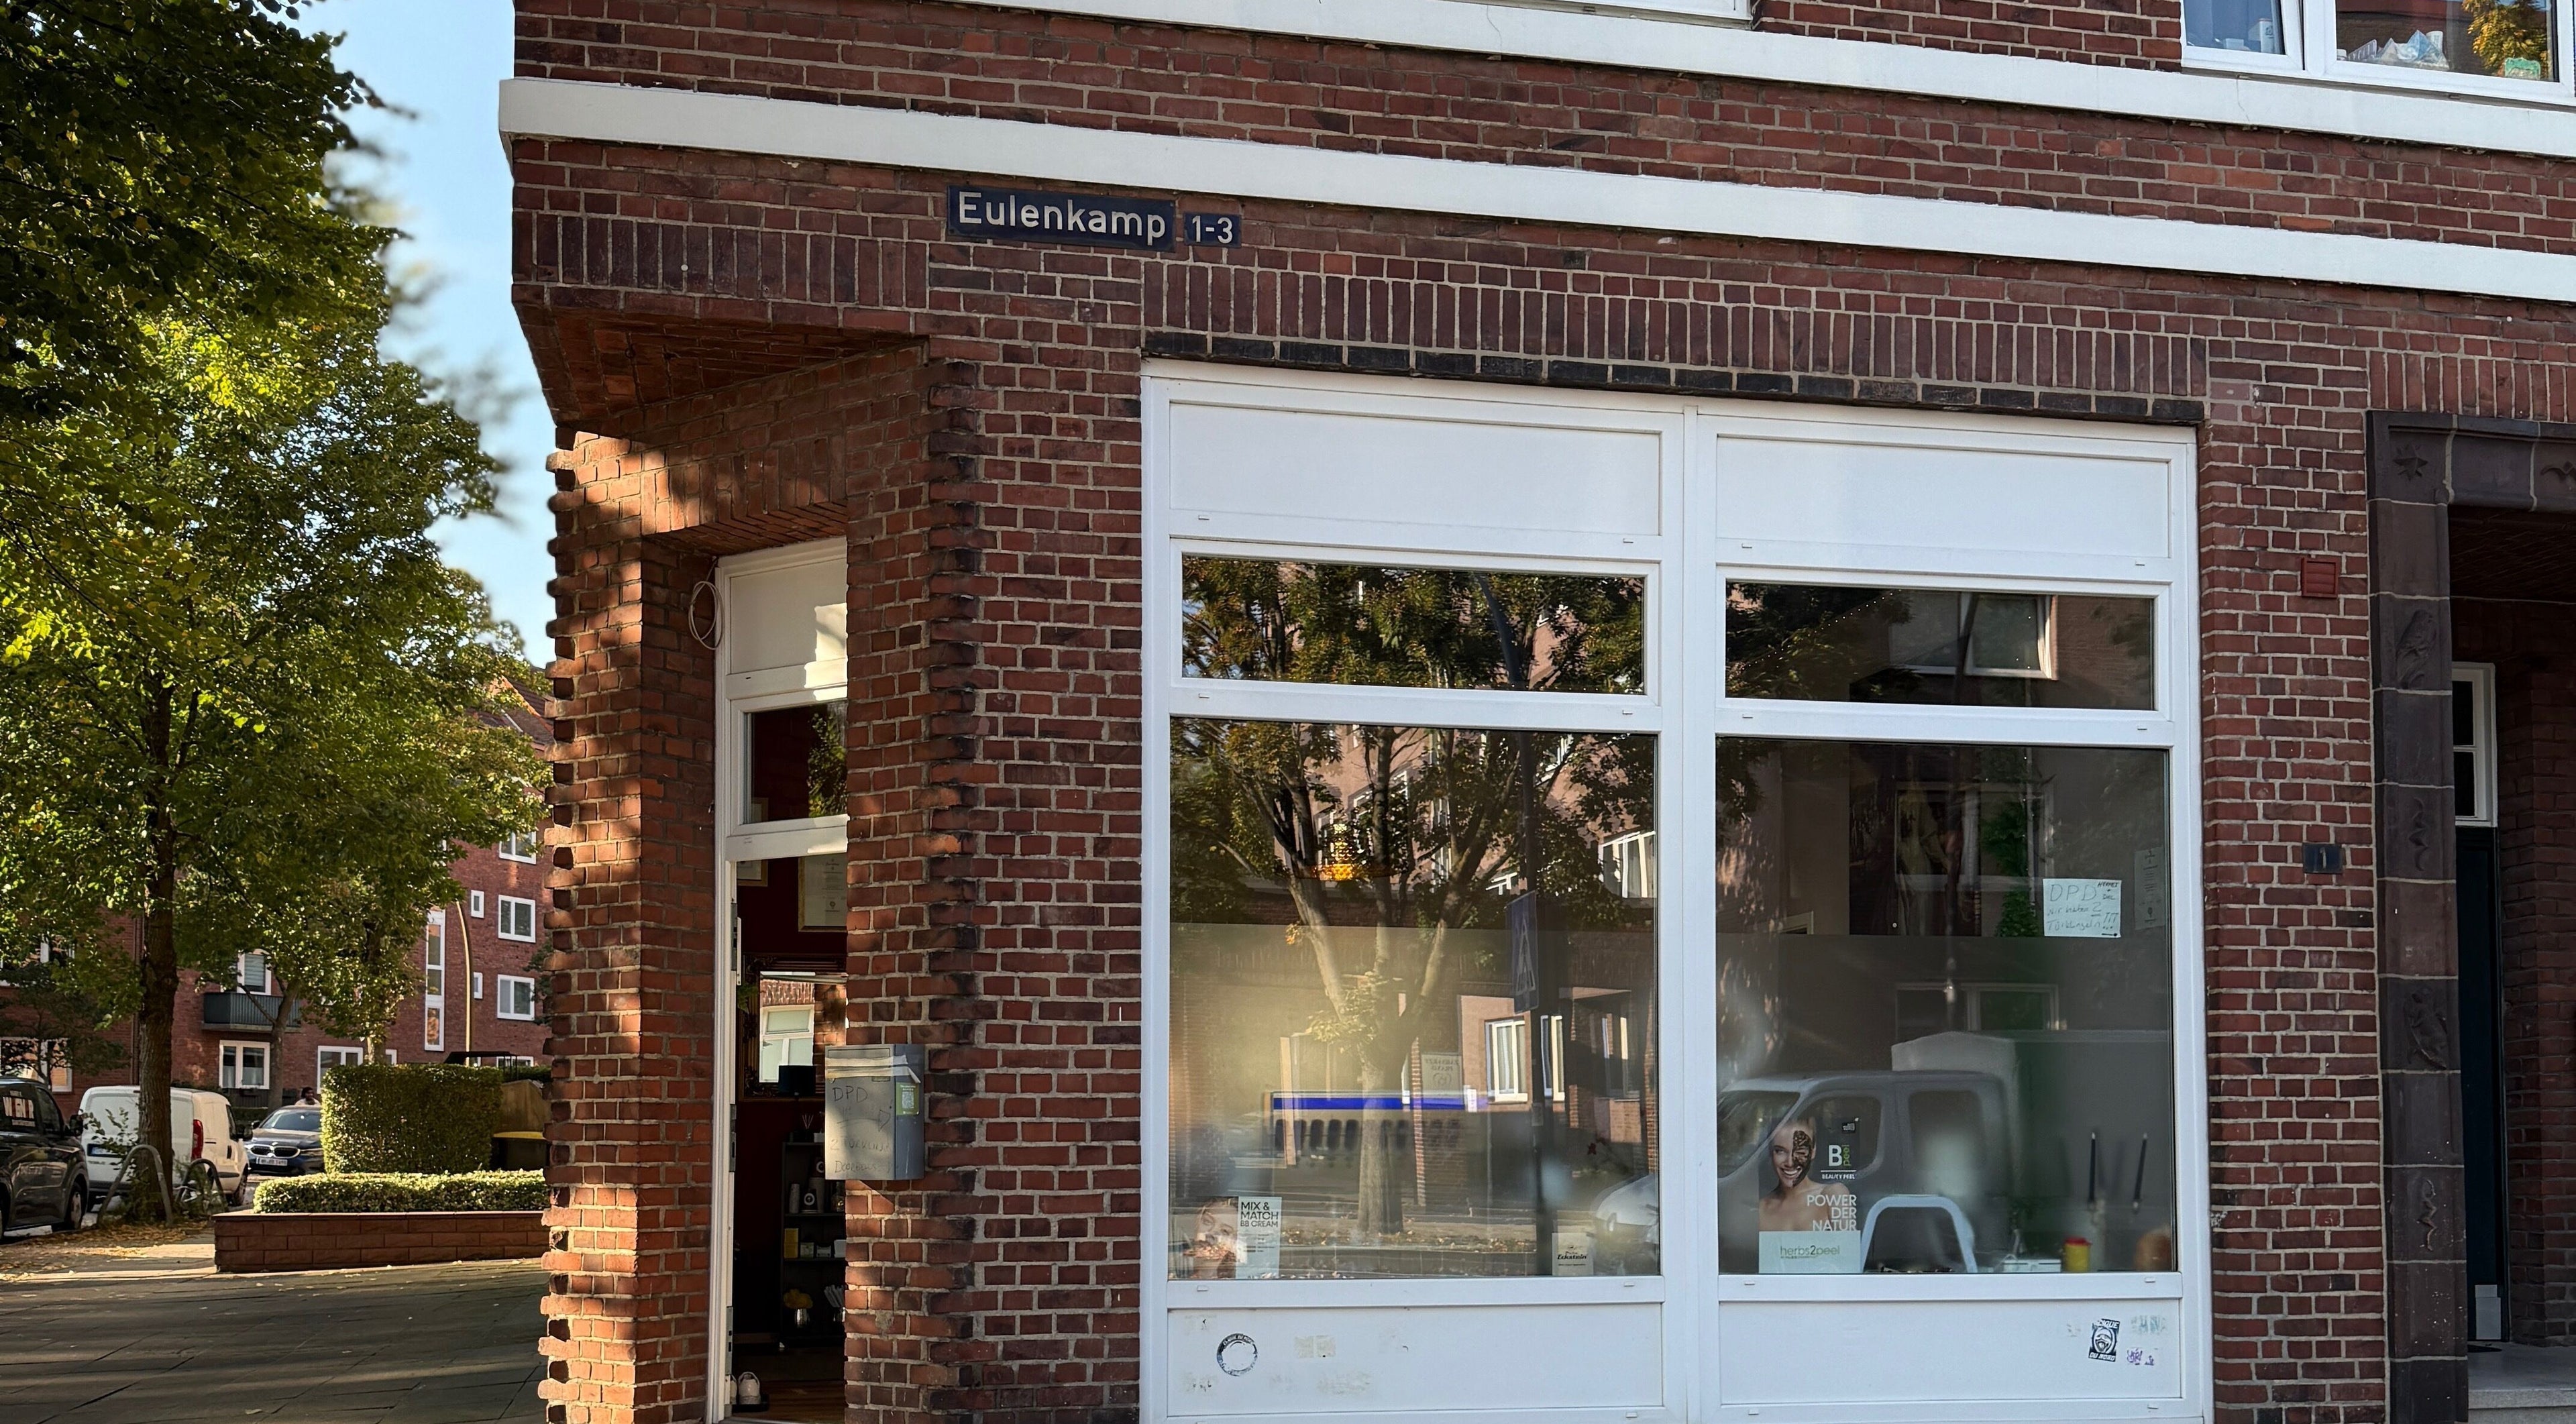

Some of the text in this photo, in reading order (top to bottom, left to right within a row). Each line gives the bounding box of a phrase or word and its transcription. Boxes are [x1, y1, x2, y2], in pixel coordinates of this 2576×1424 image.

[959, 191, 1234, 245] Eulenkamp 1-3
[2319, 847, 2327, 869] 1
[2050, 884, 2097, 901] DPD
[2092, 901, 2102, 912] 2
[833, 1085, 868, 1103] DPD
[830, 1139, 839, 1150] 2
[1828, 1144, 1842, 1166] B
[1841, 1144, 1852, 1166] peel
[1241, 1201, 1270, 1211] MIX &
[1807, 1195, 1857, 1207] POWER
[1240, 1211, 1279, 1220] MATCH
[1831, 1207, 1857, 1219] DER
[1813, 1219, 1857, 1231] NATUR
[1780, 1245, 1840, 1257] herbs2peel
